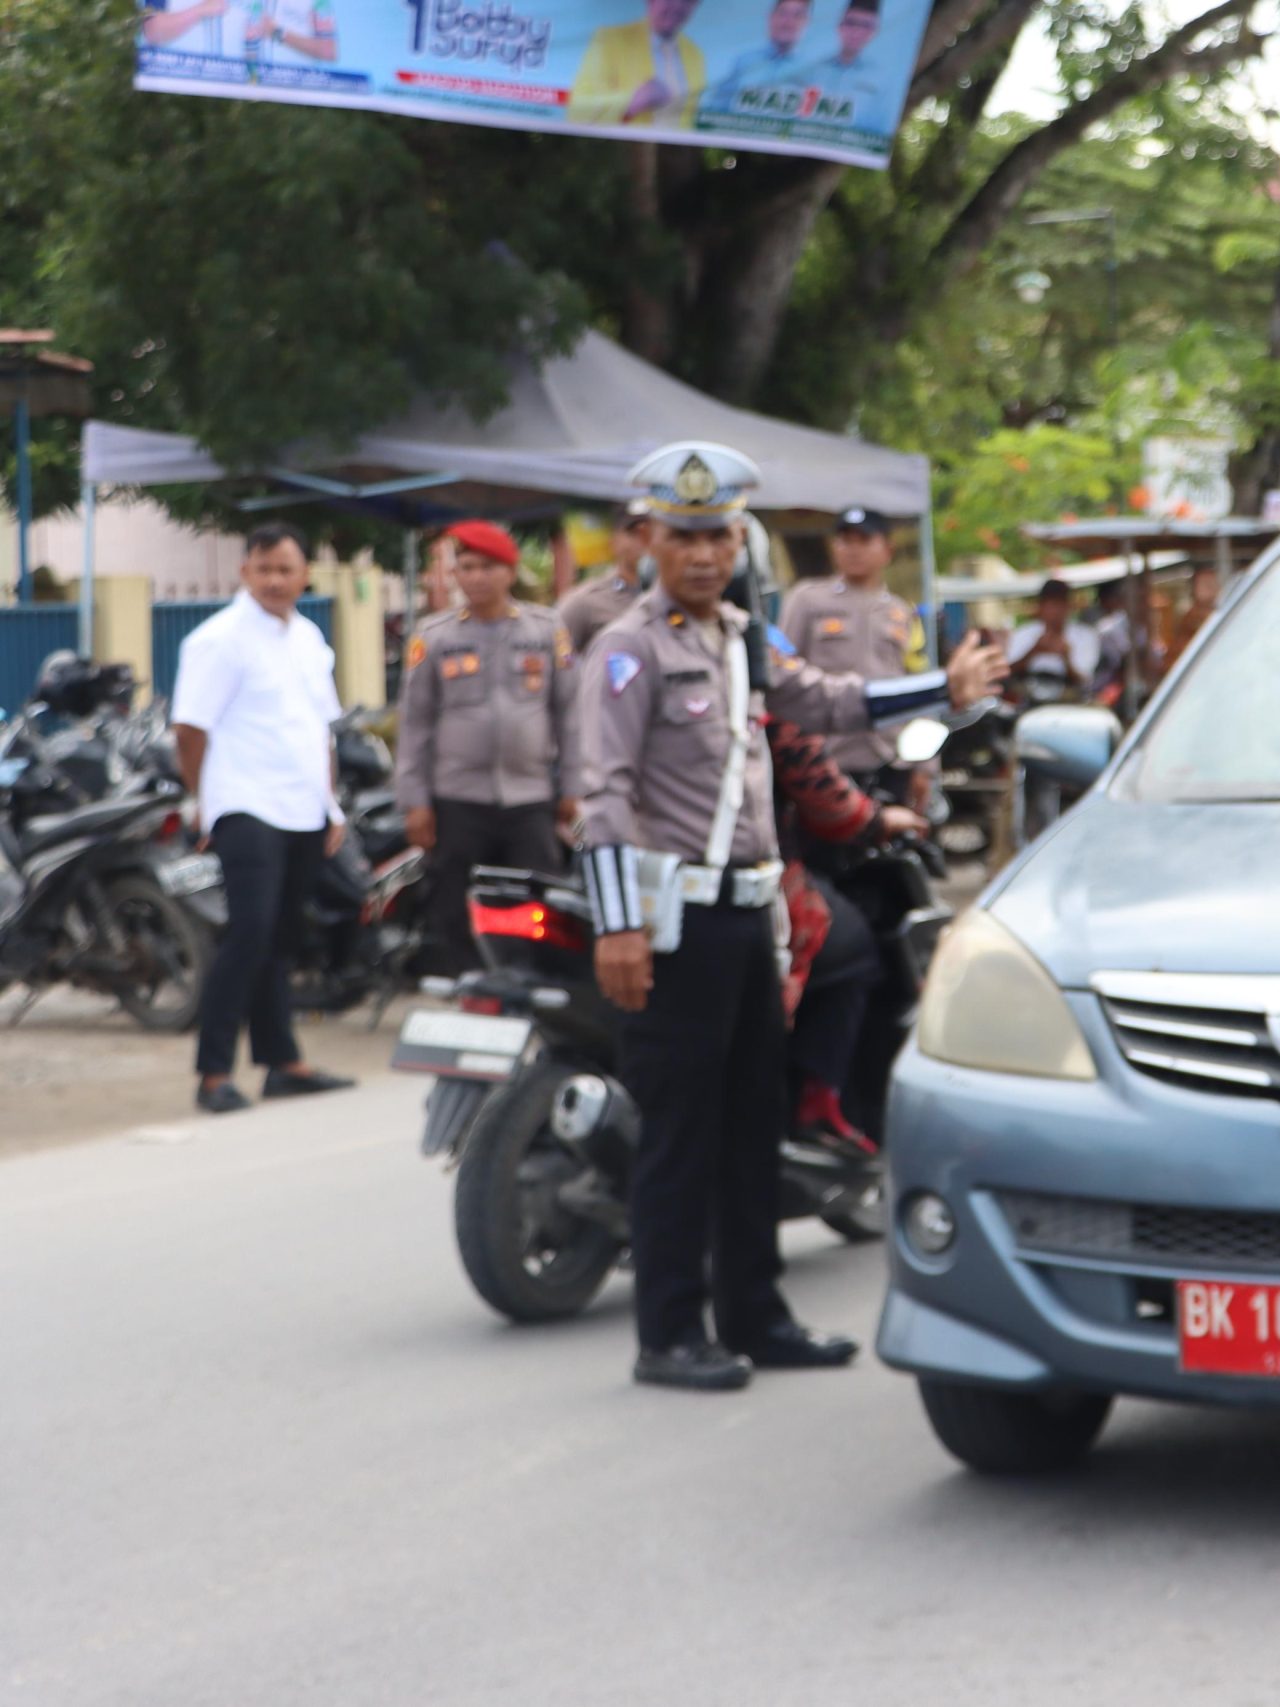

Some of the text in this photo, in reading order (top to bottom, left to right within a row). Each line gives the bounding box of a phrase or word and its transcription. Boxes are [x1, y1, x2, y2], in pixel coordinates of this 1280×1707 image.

[405, 0, 425, 53] 1
[435, 0, 551, 43] Bobby
[1184, 1284, 1235, 1340] BK
